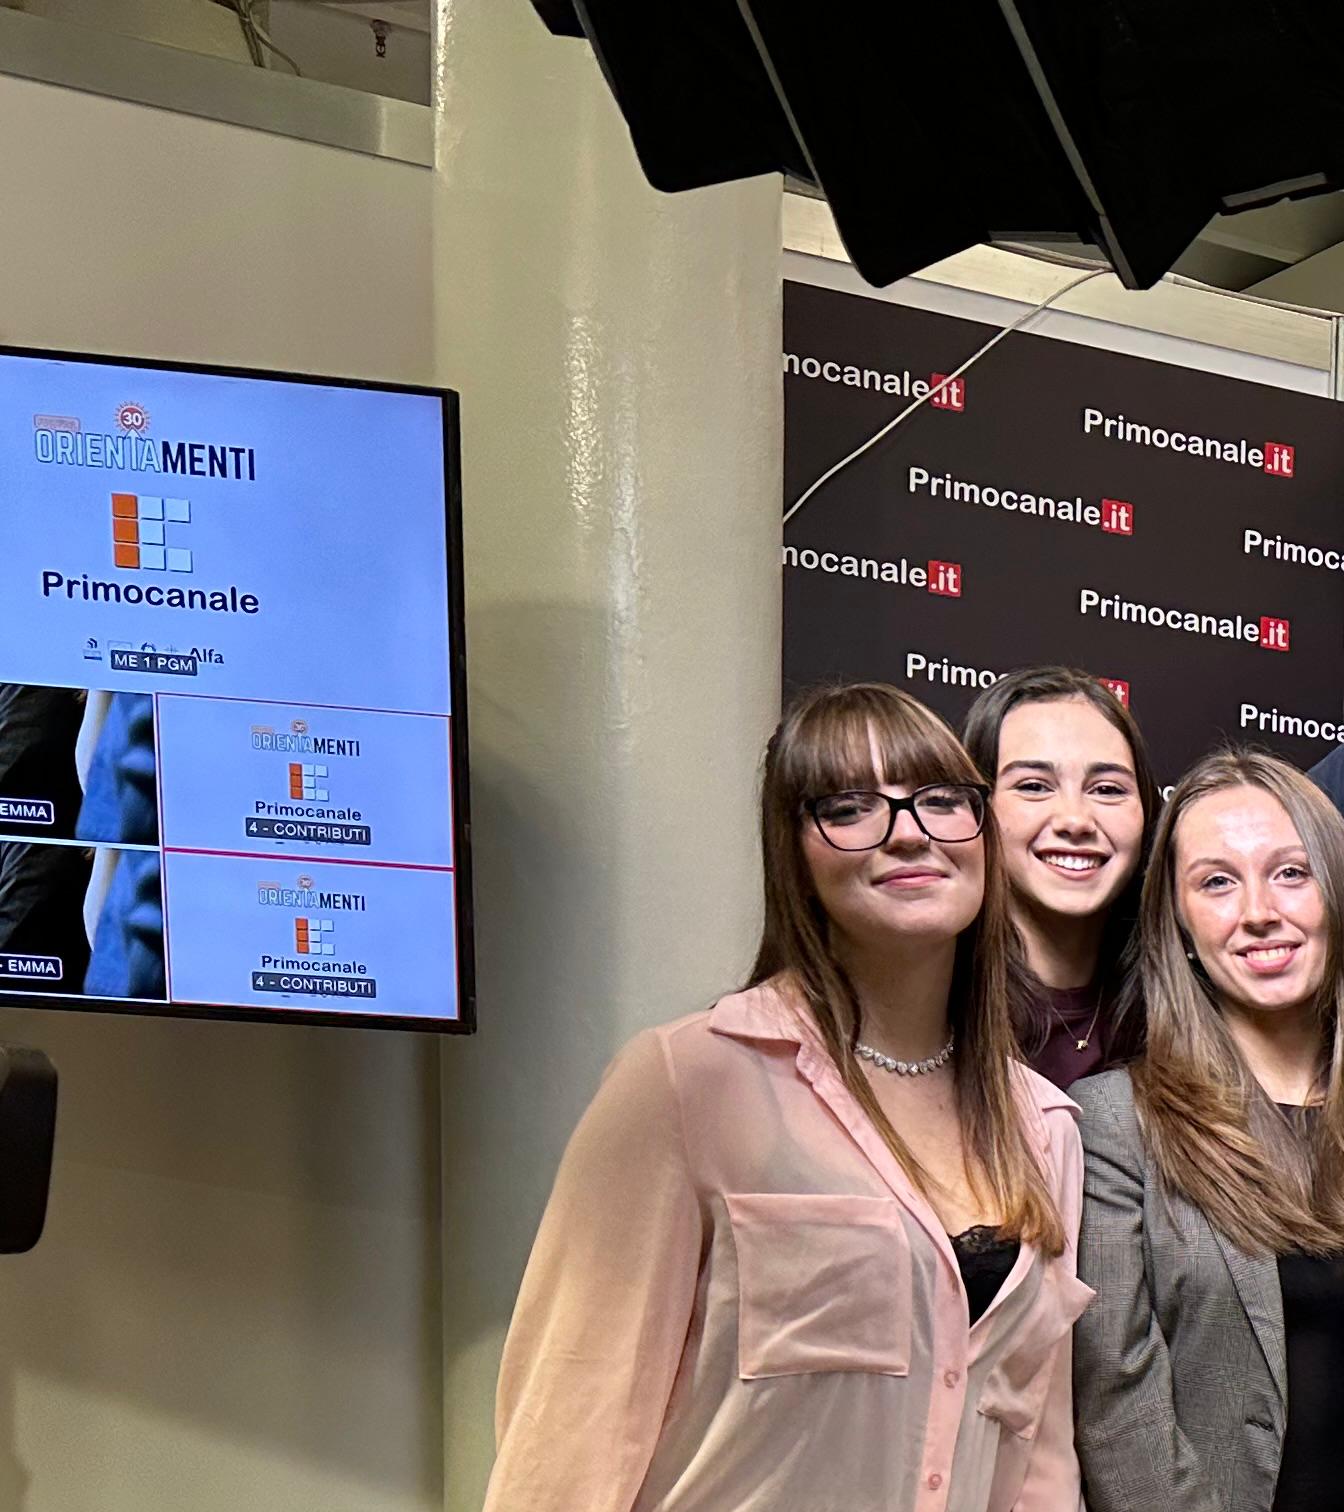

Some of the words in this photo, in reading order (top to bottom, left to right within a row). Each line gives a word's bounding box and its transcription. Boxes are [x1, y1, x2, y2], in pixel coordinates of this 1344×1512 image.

[121, 411, 143, 427] 30
[1084, 408, 1292, 474] Primocanale.it
[35, 427, 256, 481] ORIENTAMENTI
[909, 466, 1131, 532] Primocanale.it
[42, 571, 260, 614] Primocanale
[1080, 590, 1288, 648] Primocanale.it
[114, 653, 138, 668] ME
[143, 656, 151, 668] 1
[157, 657, 193, 672] PGM
[0, 803, 48, 818] EMMA
[255, 800, 362, 821] Primocanale
[249, 822, 258, 833] 4
[273, 823, 367, 841] CONTRIBUTI
[8, 959, 57, 975] EMMA
[261, 955, 367, 975] Primocanale
[255, 976, 265, 987] 4
[280, 977, 372, 995] CONTRIBUTI
